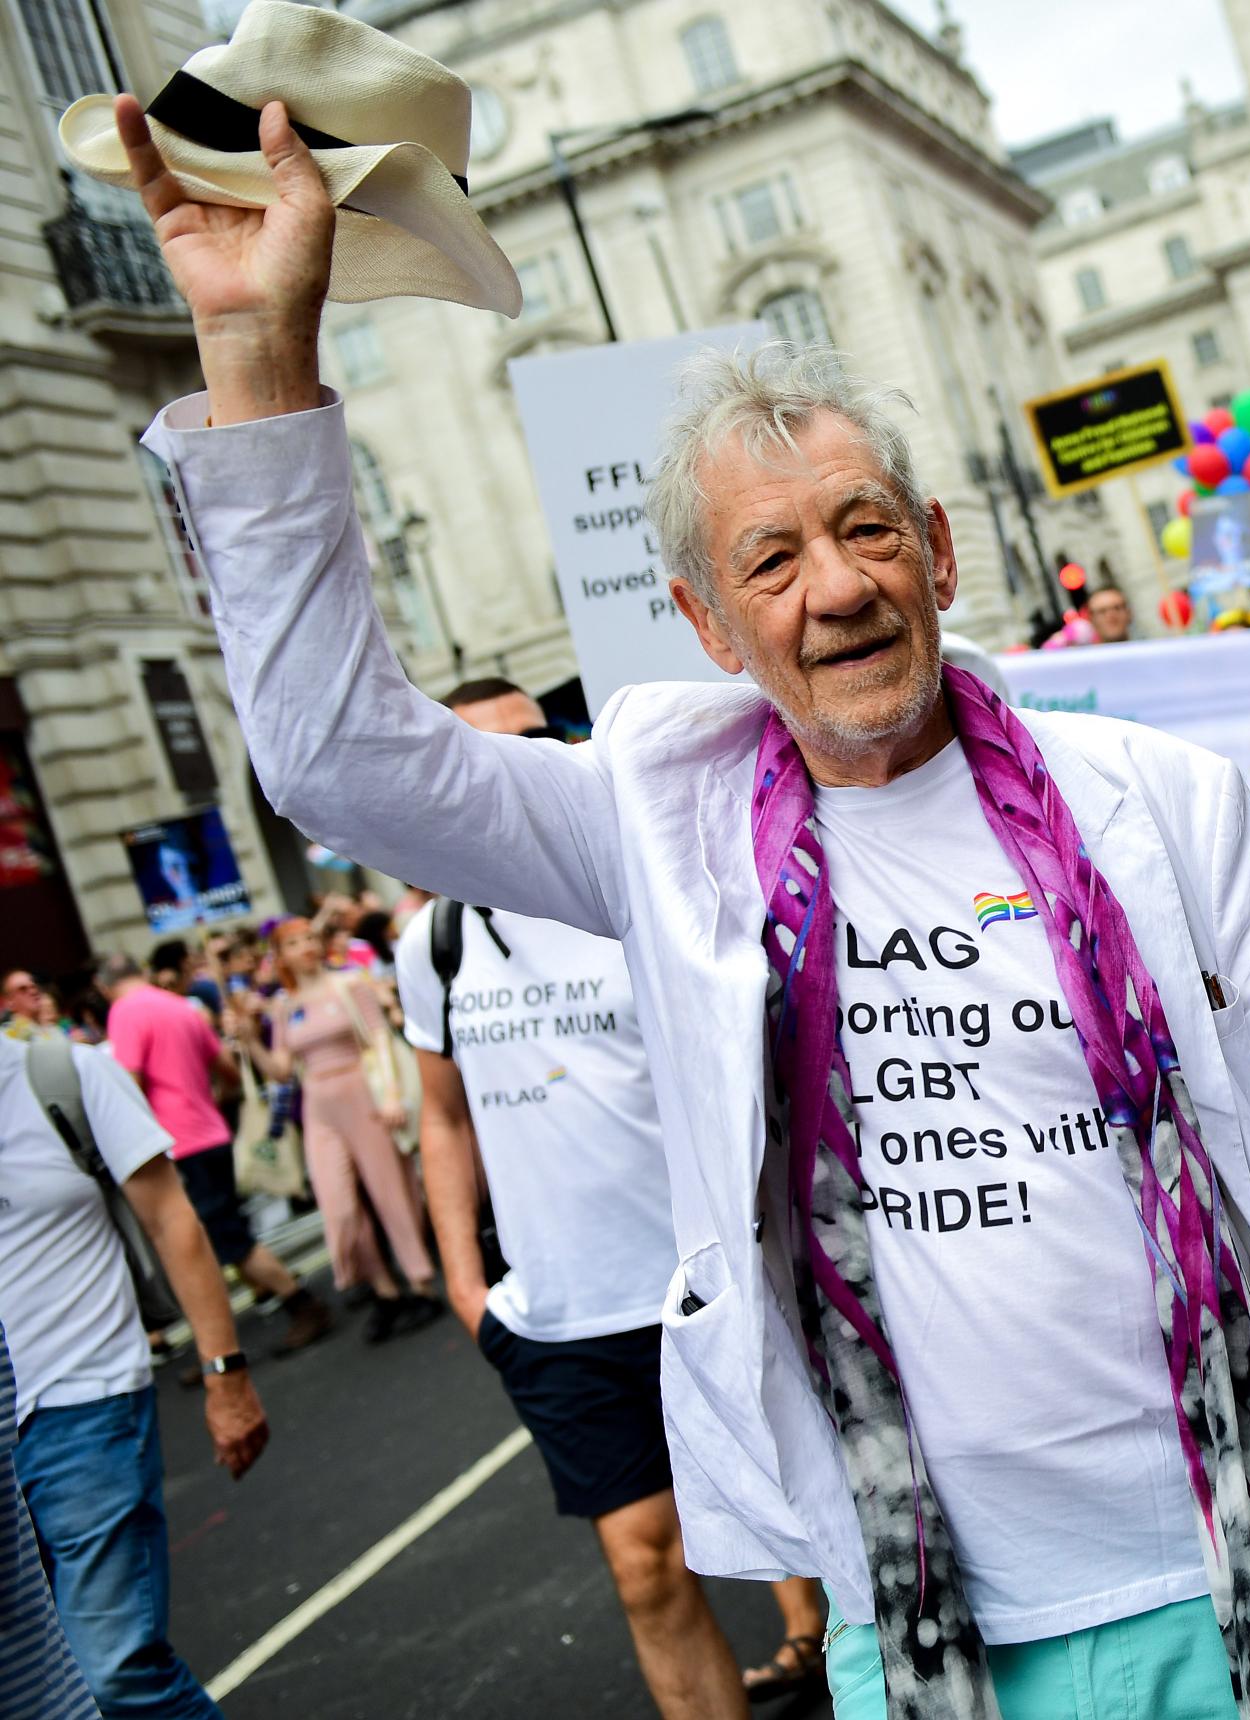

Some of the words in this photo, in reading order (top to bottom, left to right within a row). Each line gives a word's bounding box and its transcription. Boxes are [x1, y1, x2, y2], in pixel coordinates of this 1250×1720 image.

[582, 566, 657, 598] loved
[833, 921, 980, 971] LAG
[522, 983, 557, 1008] OF
[566, 977, 604, 1002] MY
[554, 1012, 617, 1037] MUM
[836, 995, 990, 1048] orting
[480, 1085, 548, 1109] FFLAG
[846, 1057, 980, 1105] LGBT
[880, 1126, 1008, 1166] ones
[1022, 1107, 1110, 1156] with
[861, 1181, 1032, 1234] PRIDE!
